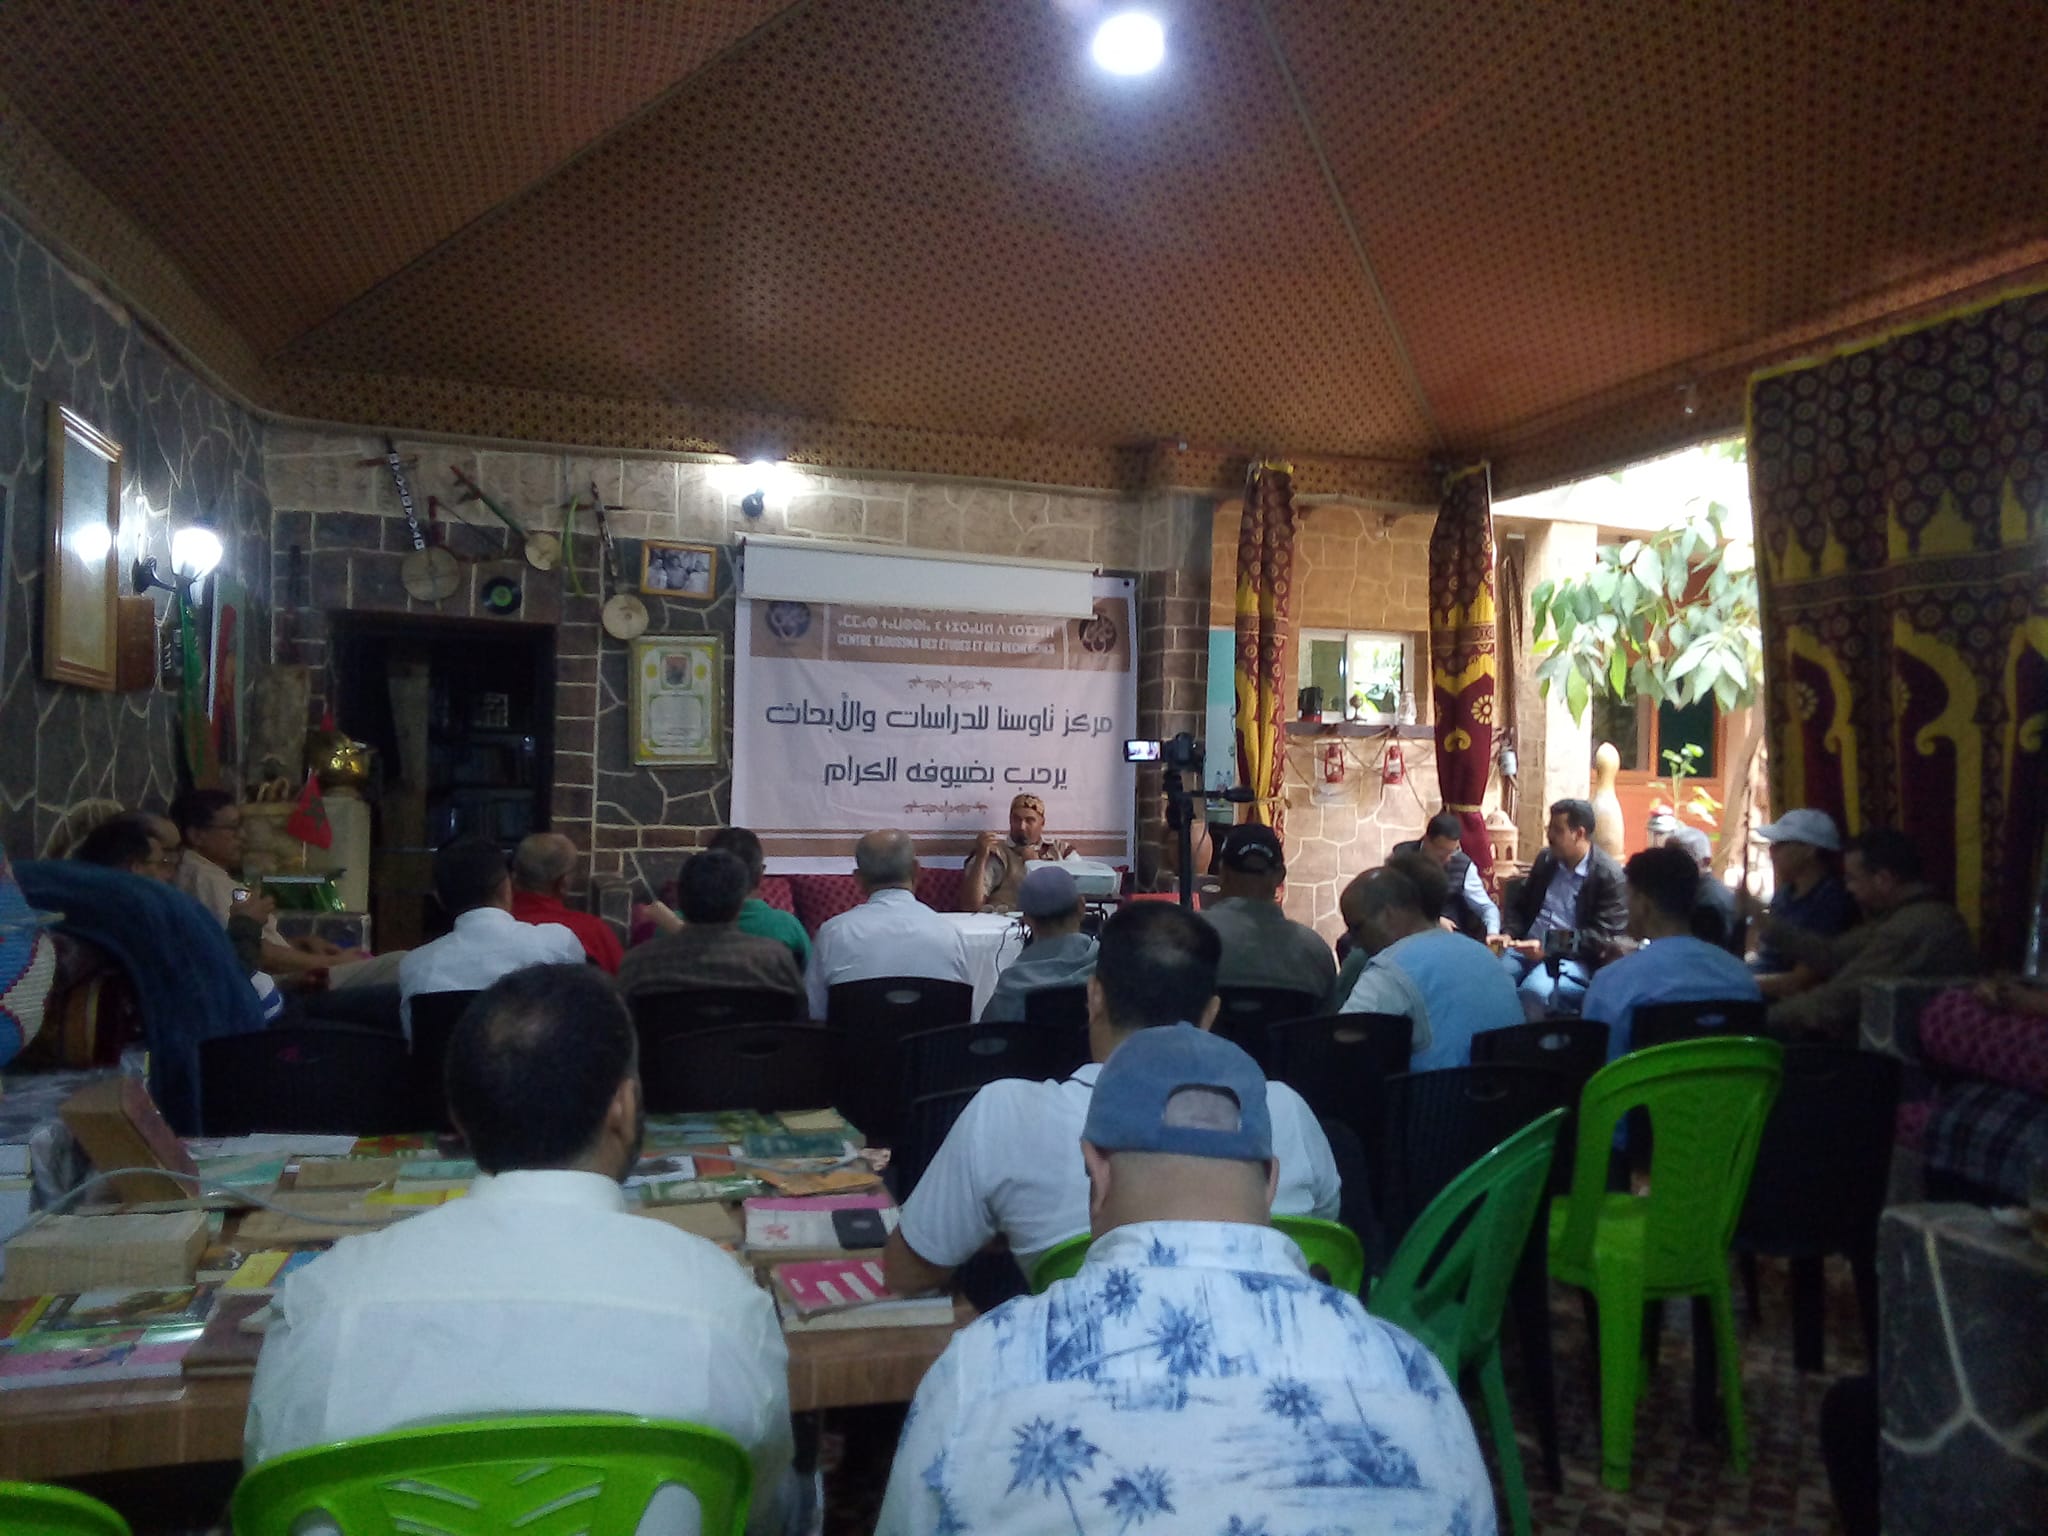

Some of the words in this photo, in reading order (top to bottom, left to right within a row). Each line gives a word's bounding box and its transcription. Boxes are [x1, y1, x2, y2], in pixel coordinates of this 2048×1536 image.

[766, 692, 876, 733] والأبحاث
[886, 703, 989, 735] للدراسات
[1061, 709, 1113, 738] مركز
[824, 755, 897, 787] الكرام
[906, 758, 995, 791] بضيوفه
[1004, 766, 1068, 791] يرحب
